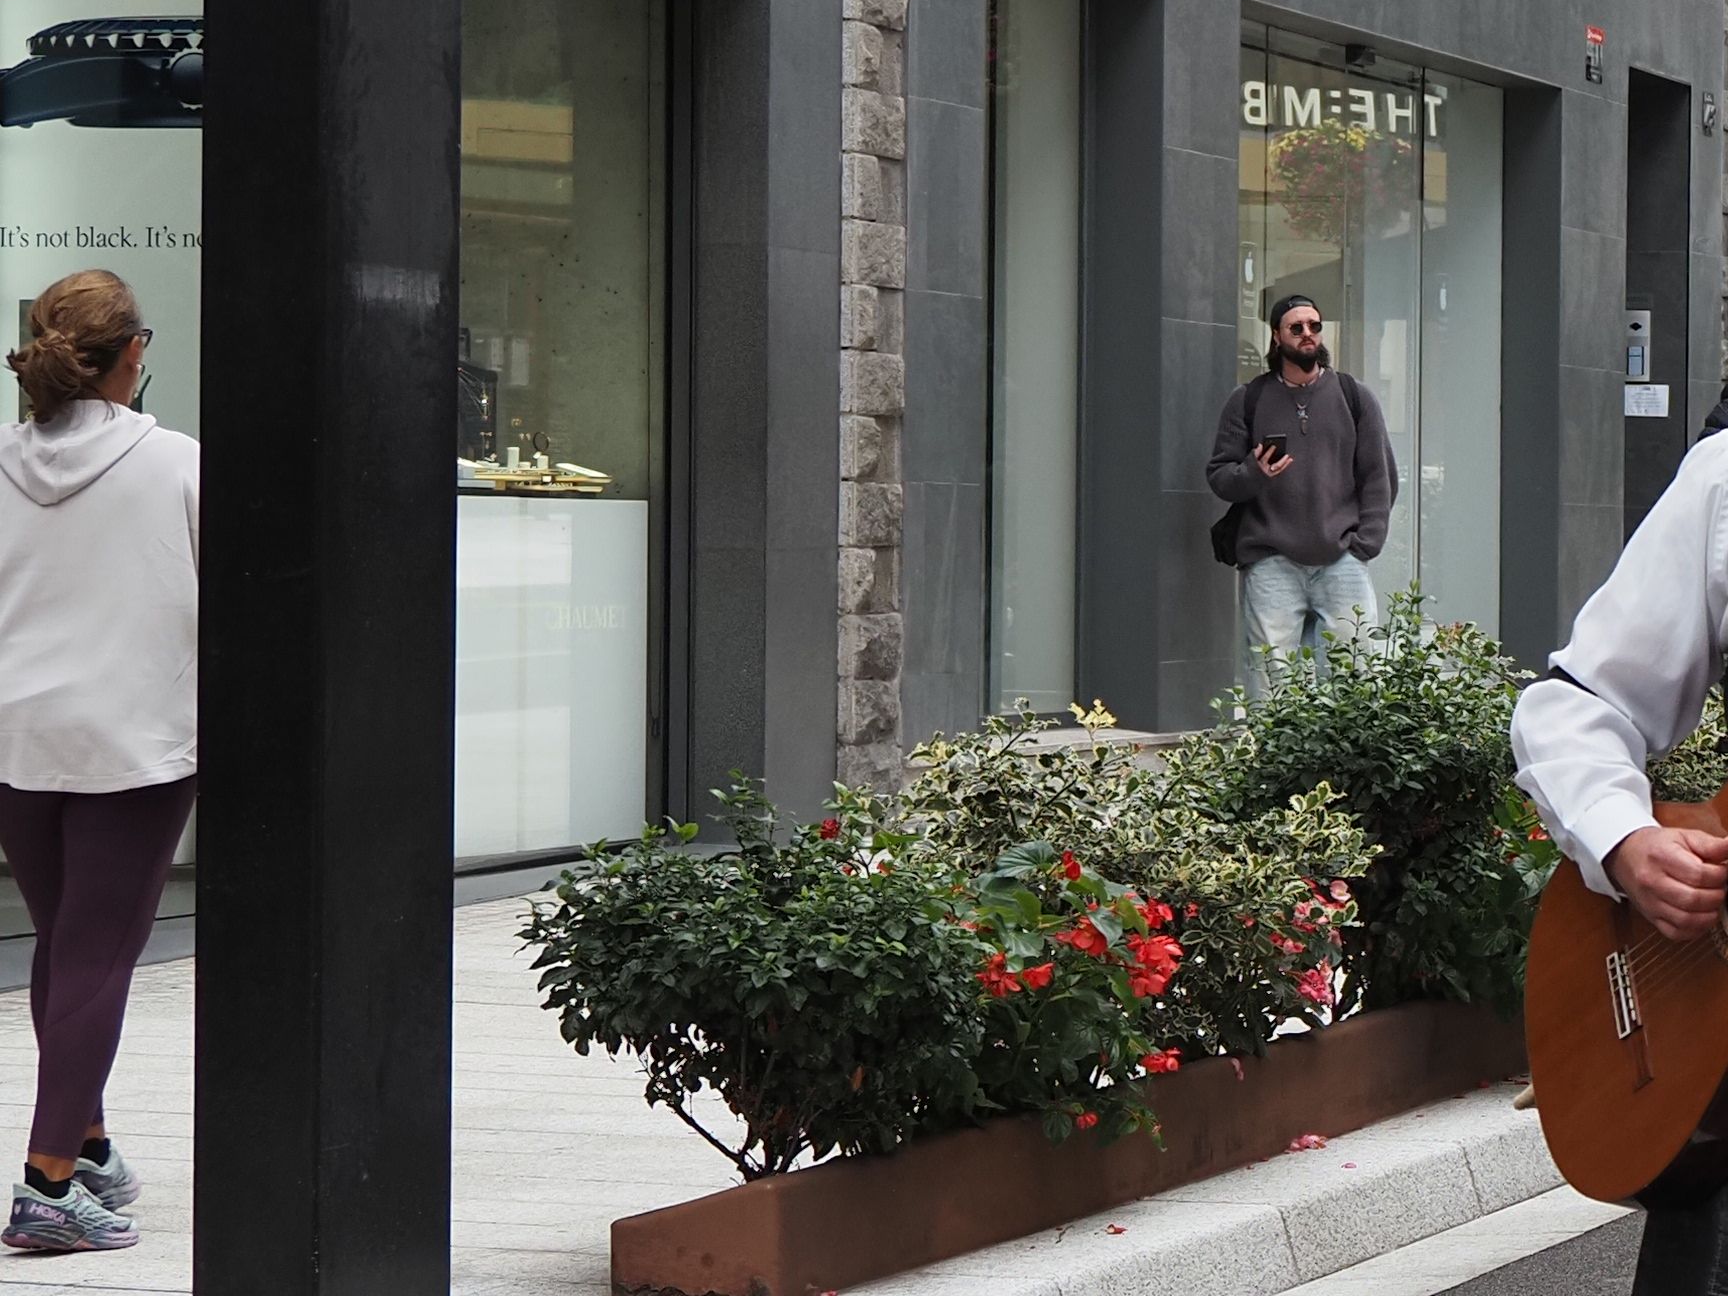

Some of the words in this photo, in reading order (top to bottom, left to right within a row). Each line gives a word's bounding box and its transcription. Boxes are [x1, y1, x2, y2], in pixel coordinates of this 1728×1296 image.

[0, 226, 30, 248] It's
[36, 230, 70, 248] not
[76, 226, 138, 248] black.
[146, 226, 177, 248] It's
